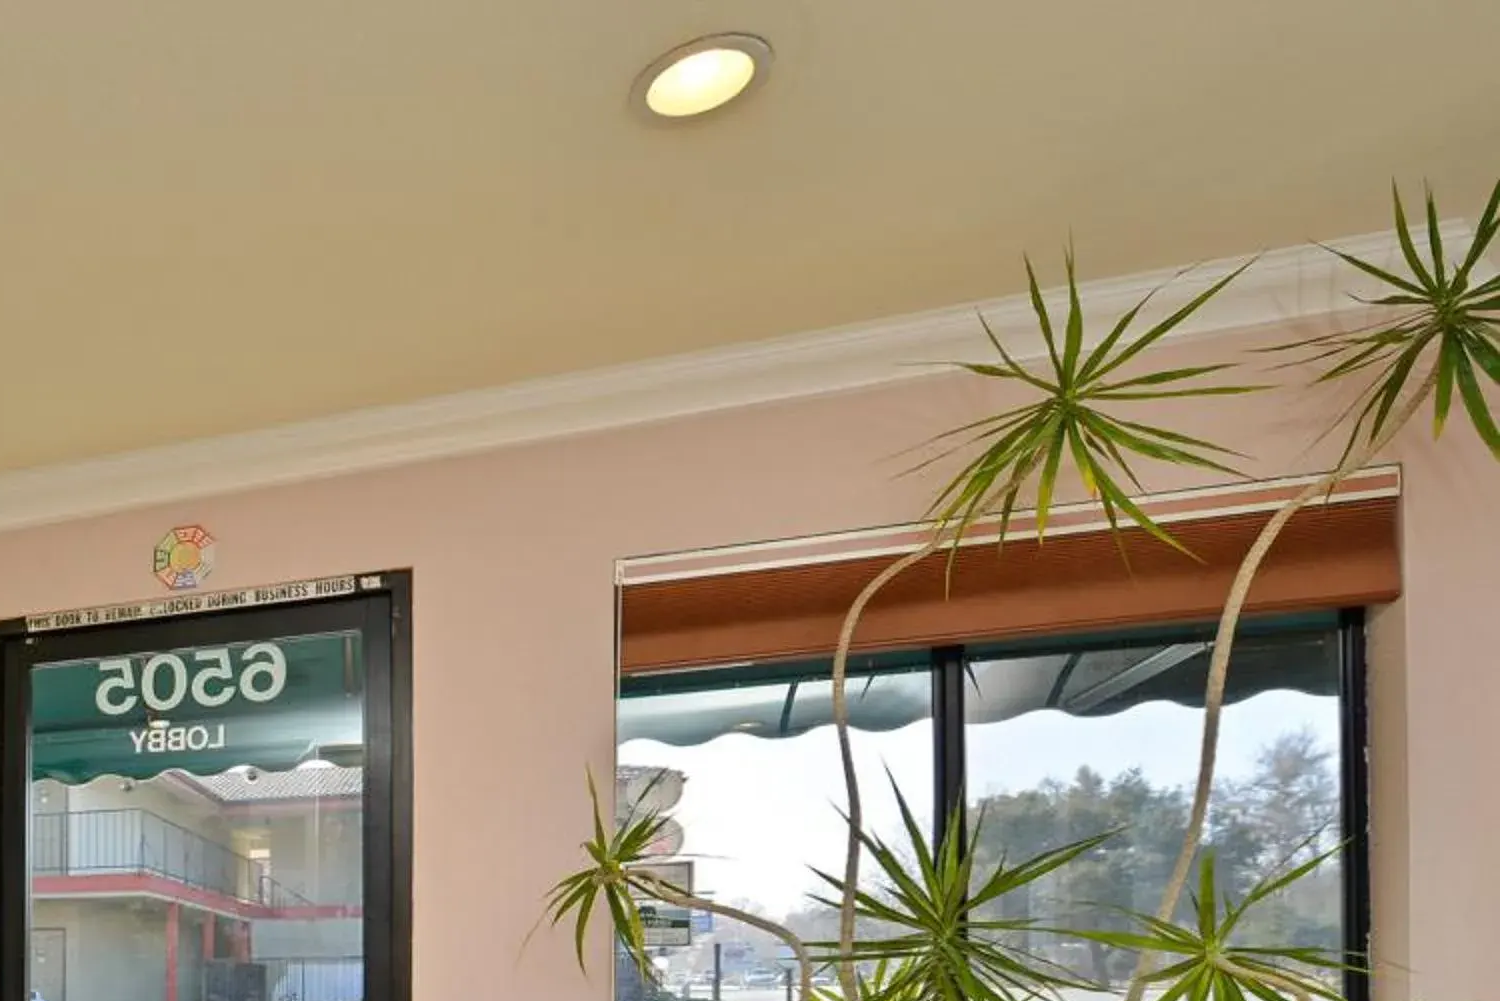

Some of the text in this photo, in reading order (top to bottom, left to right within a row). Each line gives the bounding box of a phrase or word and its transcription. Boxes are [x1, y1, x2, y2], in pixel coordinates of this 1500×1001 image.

[27, 616, 50, 630] THIS
[55, 612, 81, 628] DOOR
[86, 610, 99, 623] TO
[104, 606, 142, 622] REMAIN
[207, 591, 247, 609] DURING
[255, 584, 309, 603] BUSINESS
[315, 577, 355, 595] HOURS
